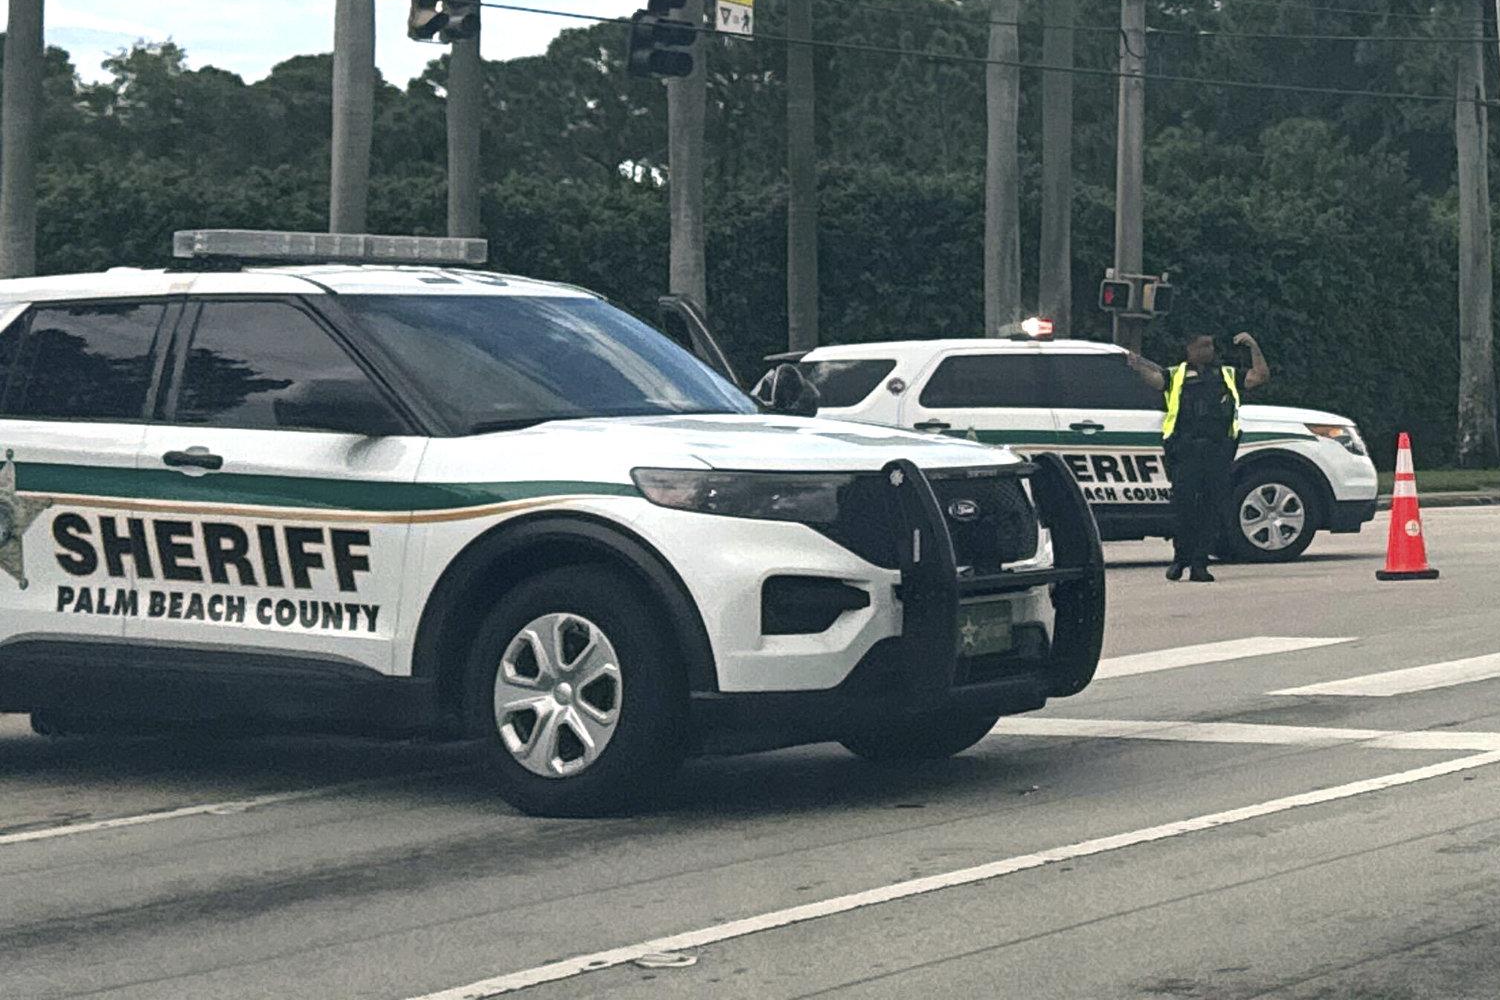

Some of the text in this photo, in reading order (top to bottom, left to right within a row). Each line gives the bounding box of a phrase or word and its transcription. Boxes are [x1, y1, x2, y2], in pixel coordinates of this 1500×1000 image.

[1062, 454, 1168, 482] ERIF
[1084, 487, 1171, 501] ACH COUN
[52, 512, 371, 592] SHERIFF
[56, 586, 381, 633] PALM BEACH COUNTY
